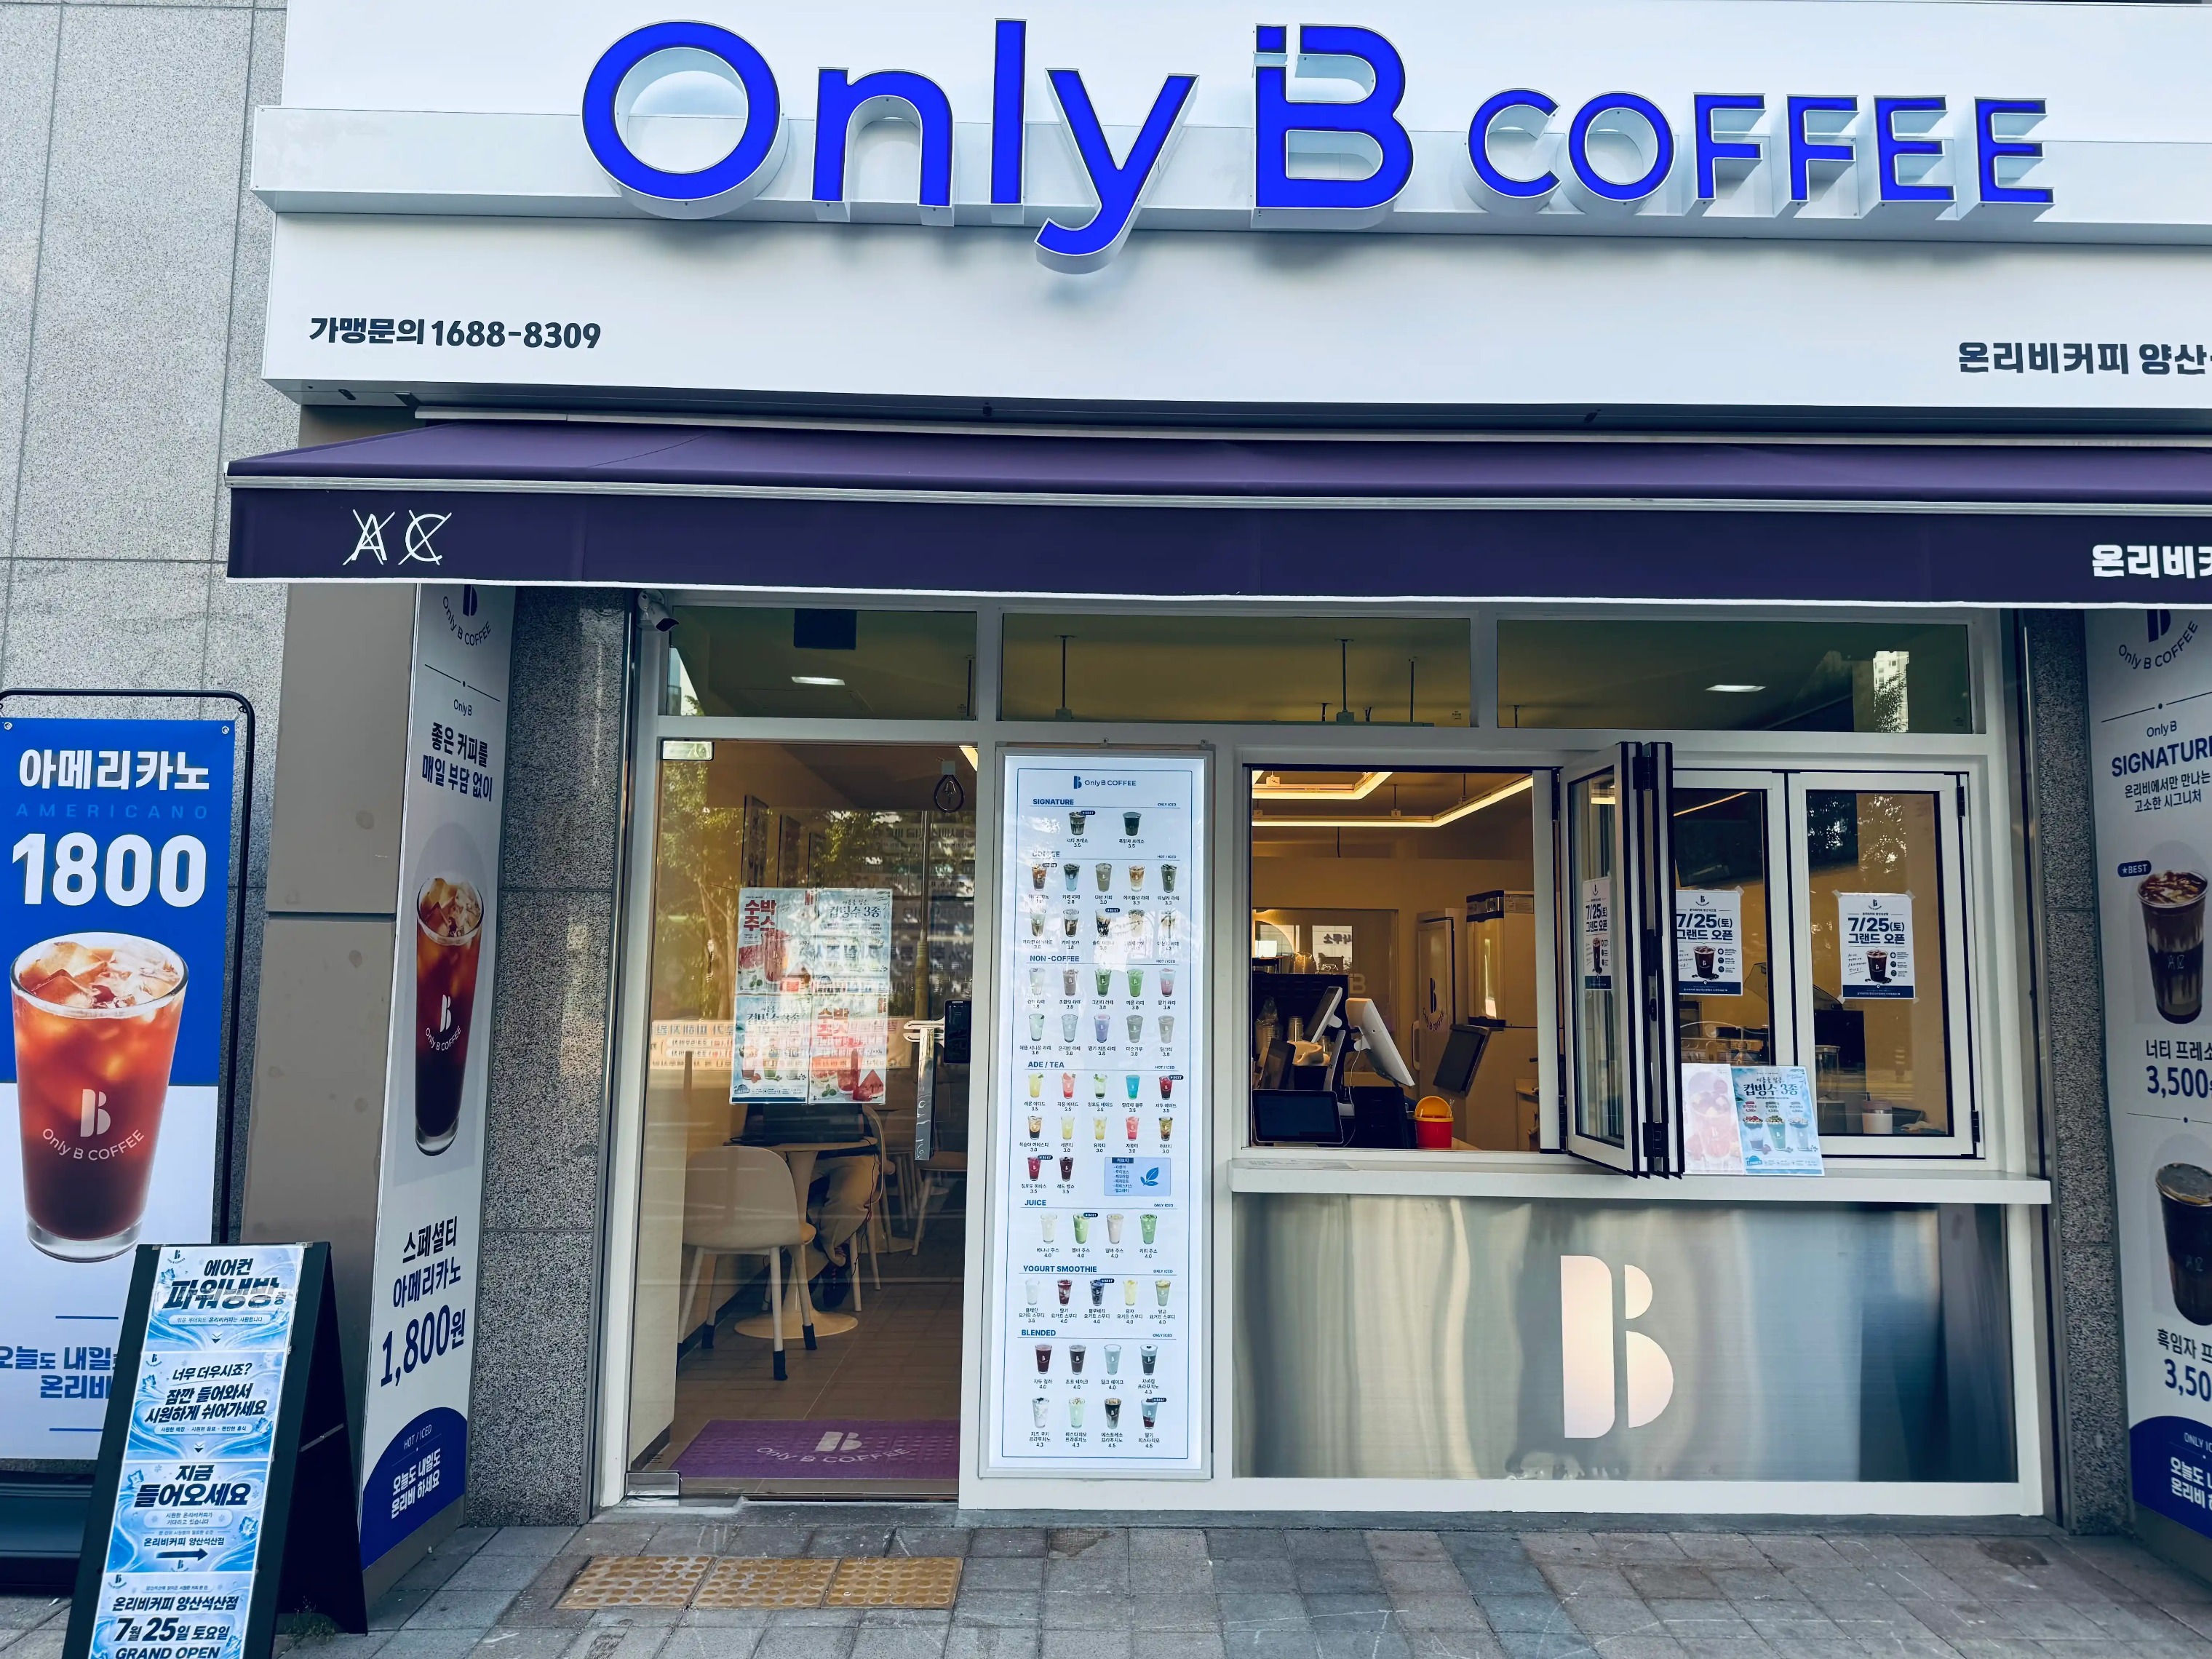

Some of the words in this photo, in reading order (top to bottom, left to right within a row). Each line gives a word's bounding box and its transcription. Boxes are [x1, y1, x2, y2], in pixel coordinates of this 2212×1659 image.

[582, 17, 1199, 260] Only
[1253, 23, 1414, 211] B
[1467, 87, 2055, 207] COFFEE
[309, 317, 425, 346] 가맹문의
[431, 319, 602, 351] 1688-8309
[1959, 342, 2129, 375] 온리비커피
[2139, 343, 2212, 375] 양산
[442, 596, 456, 632] Only
[457, 629, 464, 641] B
[464, 621, 491, 647] COFFEE
[2118, 644, 2142, 670] Only
[2143, 656, 2152, 669] B
[2155, 620, 2198, 668] COFFEE
[431, 721, 454, 755] 좋은
[458, 733, 488, 768] 커피를
[19, 749, 210, 791] 아메리카노
[422, 755, 445, 787] 매일
[448, 763, 470, 795] 부담
[472, 771, 493, 802] 없이
[2125, 775, 2179, 798] 온리비에서만
[2181, 769, 2211, 790] 만나는
[16, 803, 208, 820] AMERICANO
[2133, 797, 2162, 813] 고소한
[2163, 788, 2202, 808] 시그니처
[12, 832, 207, 907] 1800
[744, 899, 777, 915] 수박
[1676, 929, 1708, 940] 그랜드
[1711, 929, 1733, 941] 오픈
[1847, 917, 1905, 932] 7/25(토)
[1847, 933, 1881, 944] 그랜드
[1883, 933, 1906, 944] 오픈
[441, 1025, 462, 1051] COFFEE
[2146, 1039, 2171, 1059] 너티
[1743, 1083, 1779, 1096] 컵빙수
[1780, 1083, 1799, 1096] 3종
[2146, 1065, 2212, 1099] 3,500
[42, 1128, 71, 1157] Only
[73, 1147, 84, 1160] B
[88, 1129, 145, 1161] COFFEE
[402, 1216, 458, 1264] 스페셜티
[203, 1257, 254, 1277] 에어컨
[162, 1276, 280, 1310] 파워냉방
[393, 1256, 461, 1308] 아메리카노
[381, 1304, 466, 1388] 1,800원
[2157, 1328, 2197, 1360] 흑임자
[0, 1345, 56, 1370] 오늘도
[63, 1346, 117, 1371] 내일
[172, 1367, 196, 1381] 너무
[196, 1362, 253, 1380] 더우시죠?
[2164, 1358, 2211, 1402] 3,50
[40, 1374, 112, 1399] 온리비
[165, 1388, 195, 1406] 잠깐
[196, 1382, 254, 1403] 들어와서
[144, 1404, 200, 1424] 시원하게
[201, 1399, 268, 1420] 쉬어가세요
[404, 1433, 415, 1450] HOT
[419, 1424, 432, 1440] ICED
[2184, 1432, 2204, 1448] ONLY
[756, 1447, 797, 1461] Only
[821, 1448, 911, 1463] COFFEE
[175, 1464, 215, 1481] 지금
[392, 1464, 417, 1497] 오늘도
[418, 1447, 441, 1478] 내일도
[2170, 1456, 2205, 1487] 오늘도
[134, 1483, 252, 1508] 들어오세요
[391, 1485, 416, 1519] 온리비
[417, 1468, 440, 1500] 하세요
[2171, 1476, 2205, 1508] 온리비
[143, 1537, 186, 1547] 온리비커피
[188, 1537, 225, 1546] 양산석산점
[112, 1596, 175, 1612] 온리비커피
[175, 1595, 239, 1611] 양산석산점
[114, 1617, 143, 1642] 7월
[142, 1617, 191, 1642] 25일
[191, 1625, 231, 1641] 토요일
[115, 1647, 172, 1659] GRAND
[175, 1647, 221, 1659] OPEN
